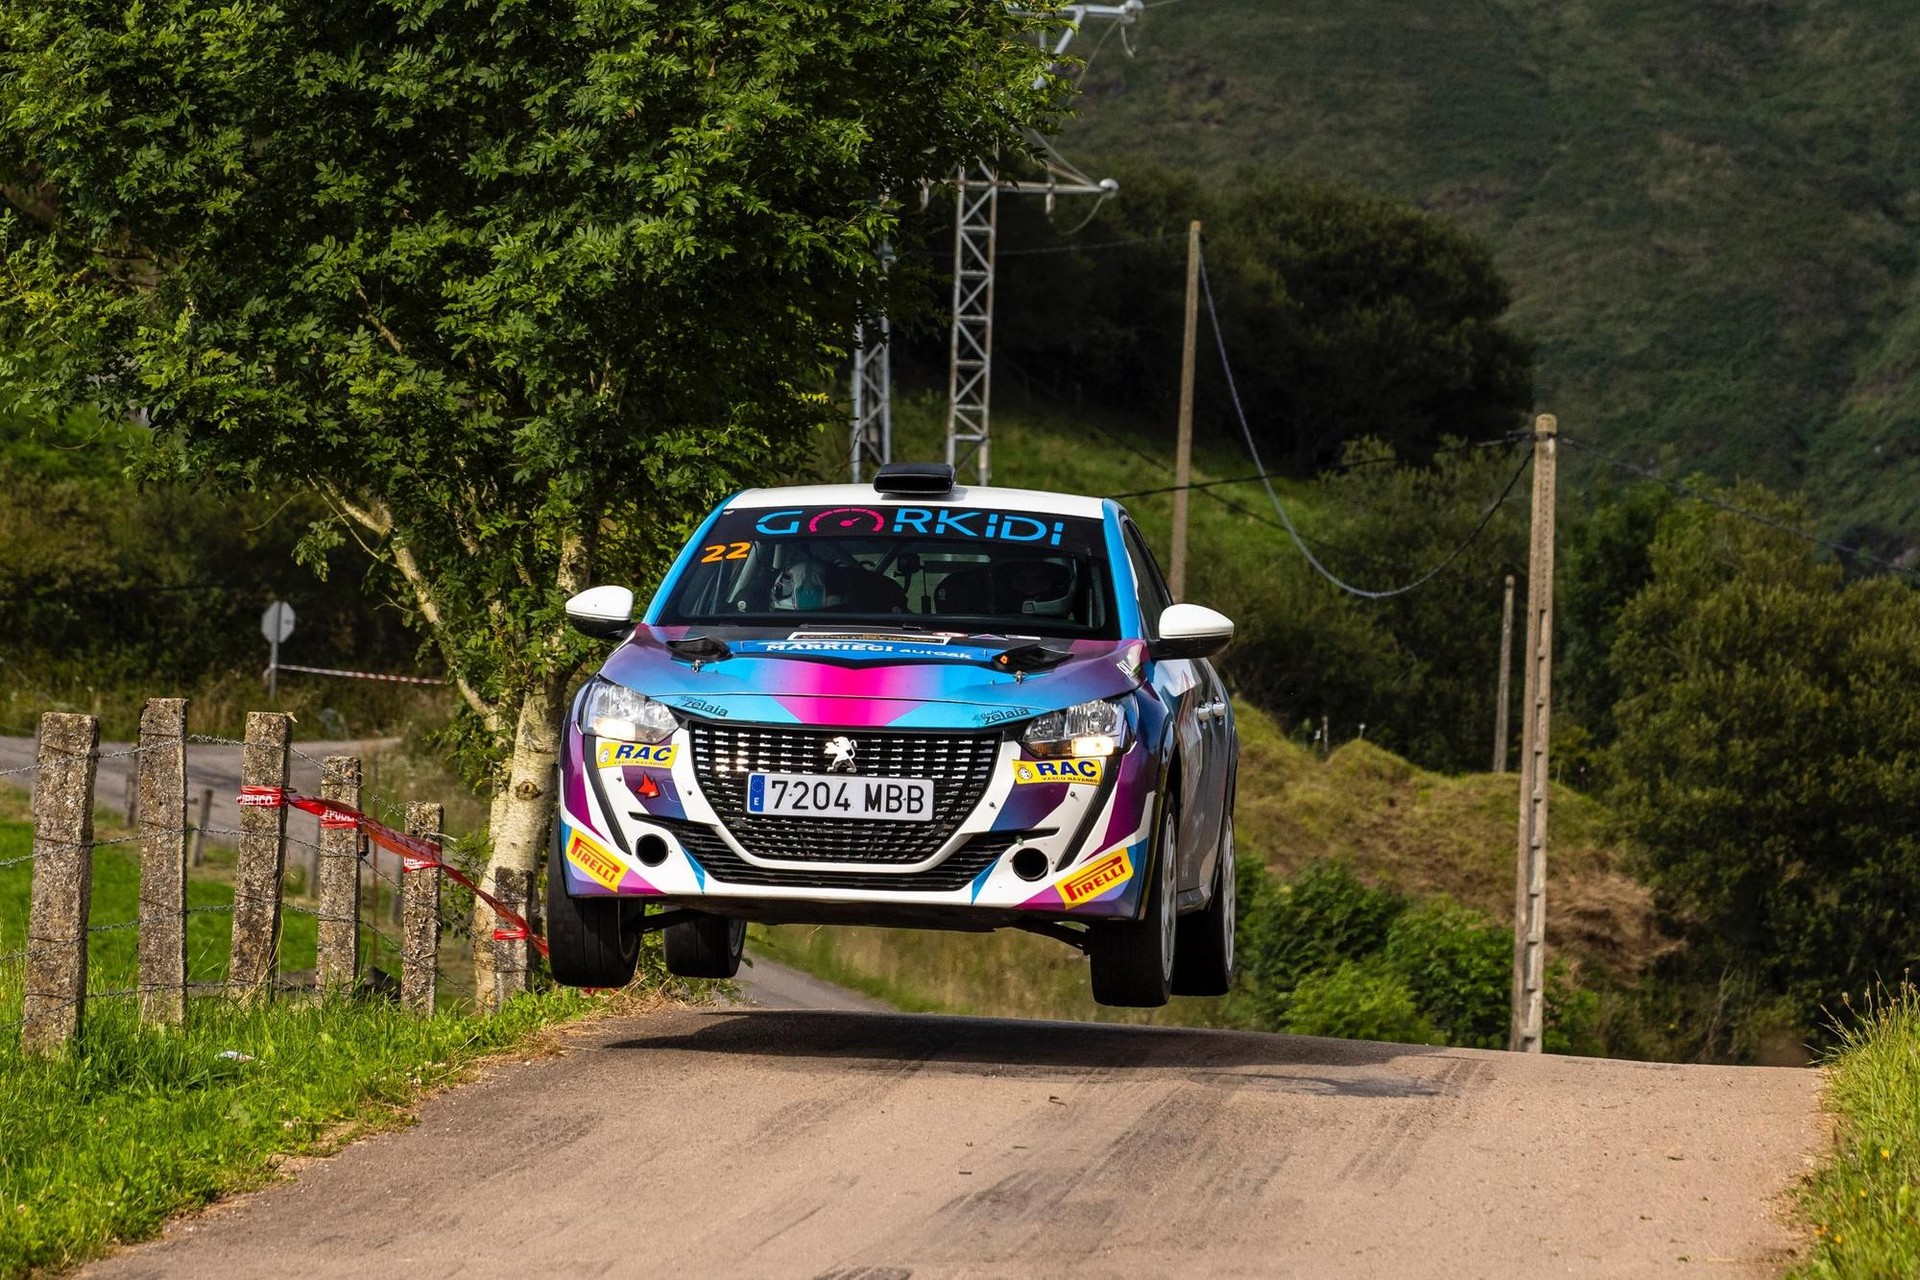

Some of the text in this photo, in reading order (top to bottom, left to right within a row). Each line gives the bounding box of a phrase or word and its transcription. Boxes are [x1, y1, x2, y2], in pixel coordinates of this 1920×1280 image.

[701, 541, 751, 563] 22
[615, 744, 672, 762] RAC
[1035, 761, 1097, 778] RAC
[753, 797, 760, 806] E
[771, 780, 925, 814] 7204 MBB
[571, 836, 621, 883] PIRELLI
[1063, 855, 1126, 902] PIRELLI
